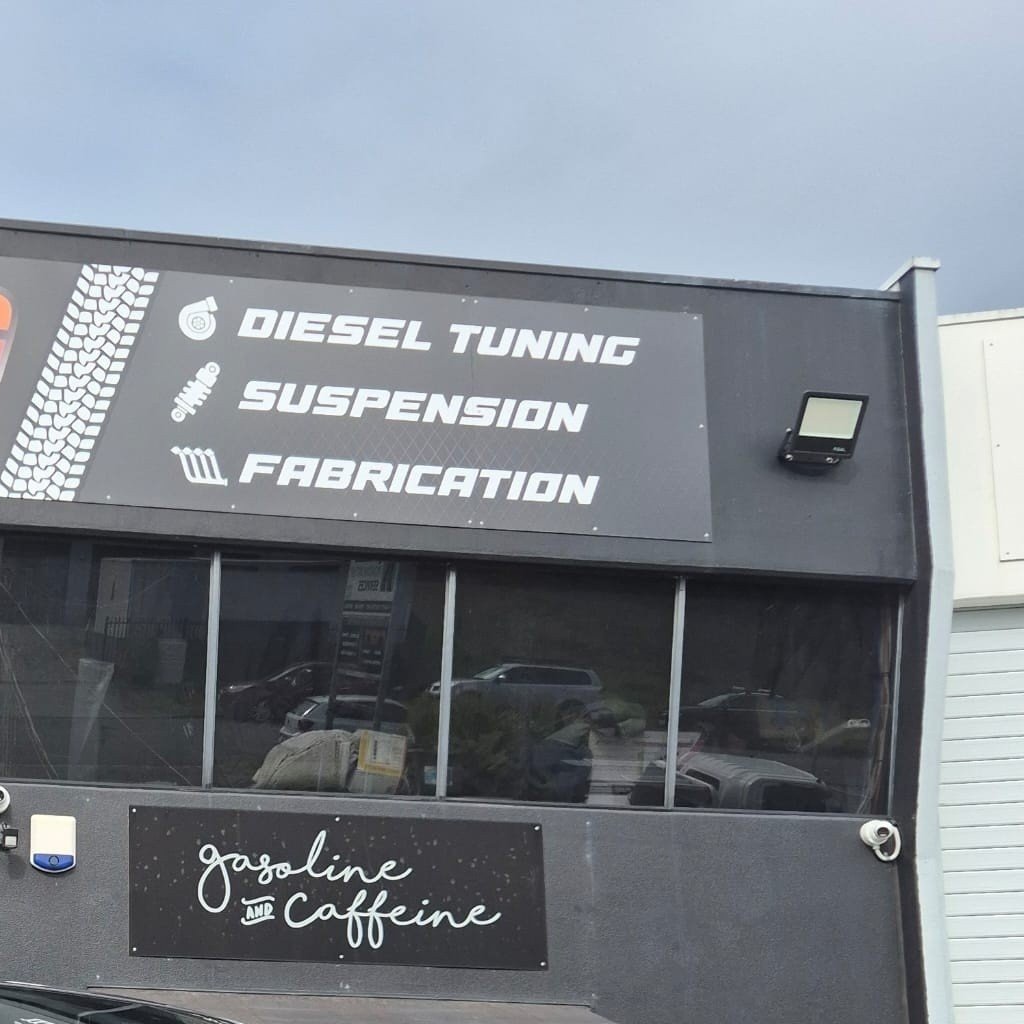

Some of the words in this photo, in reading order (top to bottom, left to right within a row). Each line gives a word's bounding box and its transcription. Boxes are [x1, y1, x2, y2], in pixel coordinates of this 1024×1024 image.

[238, 308, 432, 351] DIESEL
[449, 323, 641, 366] TUNING
[237, 380, 589, 433] SUSPENSION
[238, 453, 600, 505] FABRICATION
[197, 830, 413, 914] gasoline
